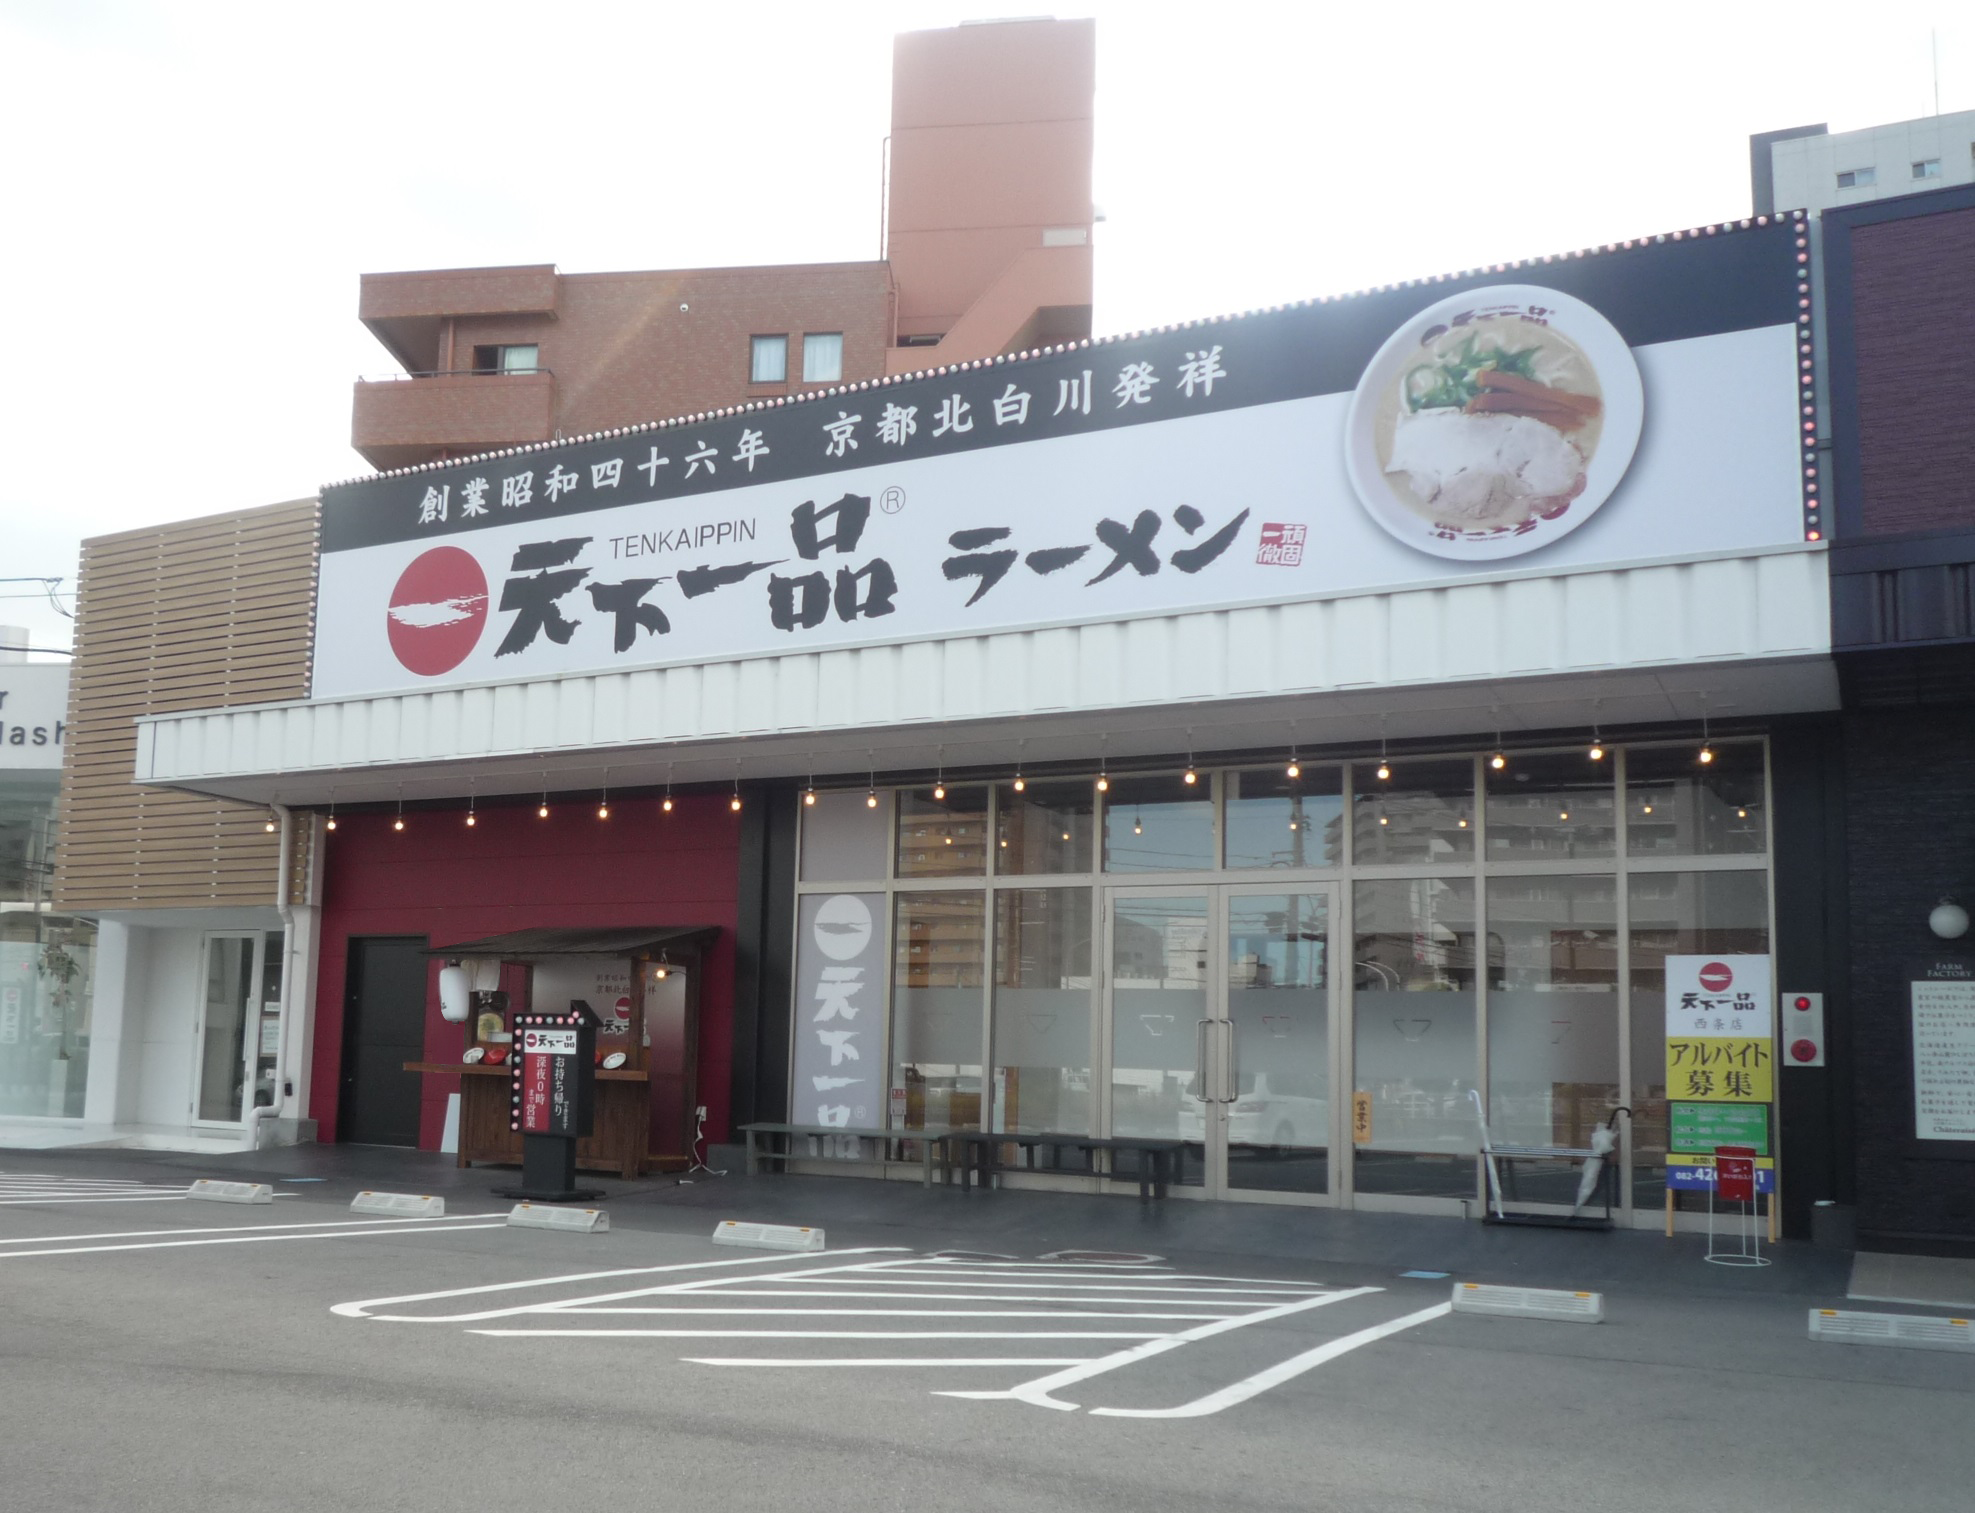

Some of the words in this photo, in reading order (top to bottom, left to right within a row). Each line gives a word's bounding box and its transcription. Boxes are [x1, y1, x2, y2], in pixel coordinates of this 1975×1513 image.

[418, 429, 770, 524] 創業昭和四十六年
[822, 345, 1227, 457] 京都北白川発祥
[609, 518, 756, 559] TENKAIPPIN
[494, 493, 898, 658] 天下一品
[941, 504, 1250, 608] ラーメン
[1681, 992, 1756, 1011] 天下一品
[537, 1034, 576, 1049] 天下一品
[1669, 1042, 1769, 1068] アルバイト
[1685, 1070, 1753, 1098] 募集
